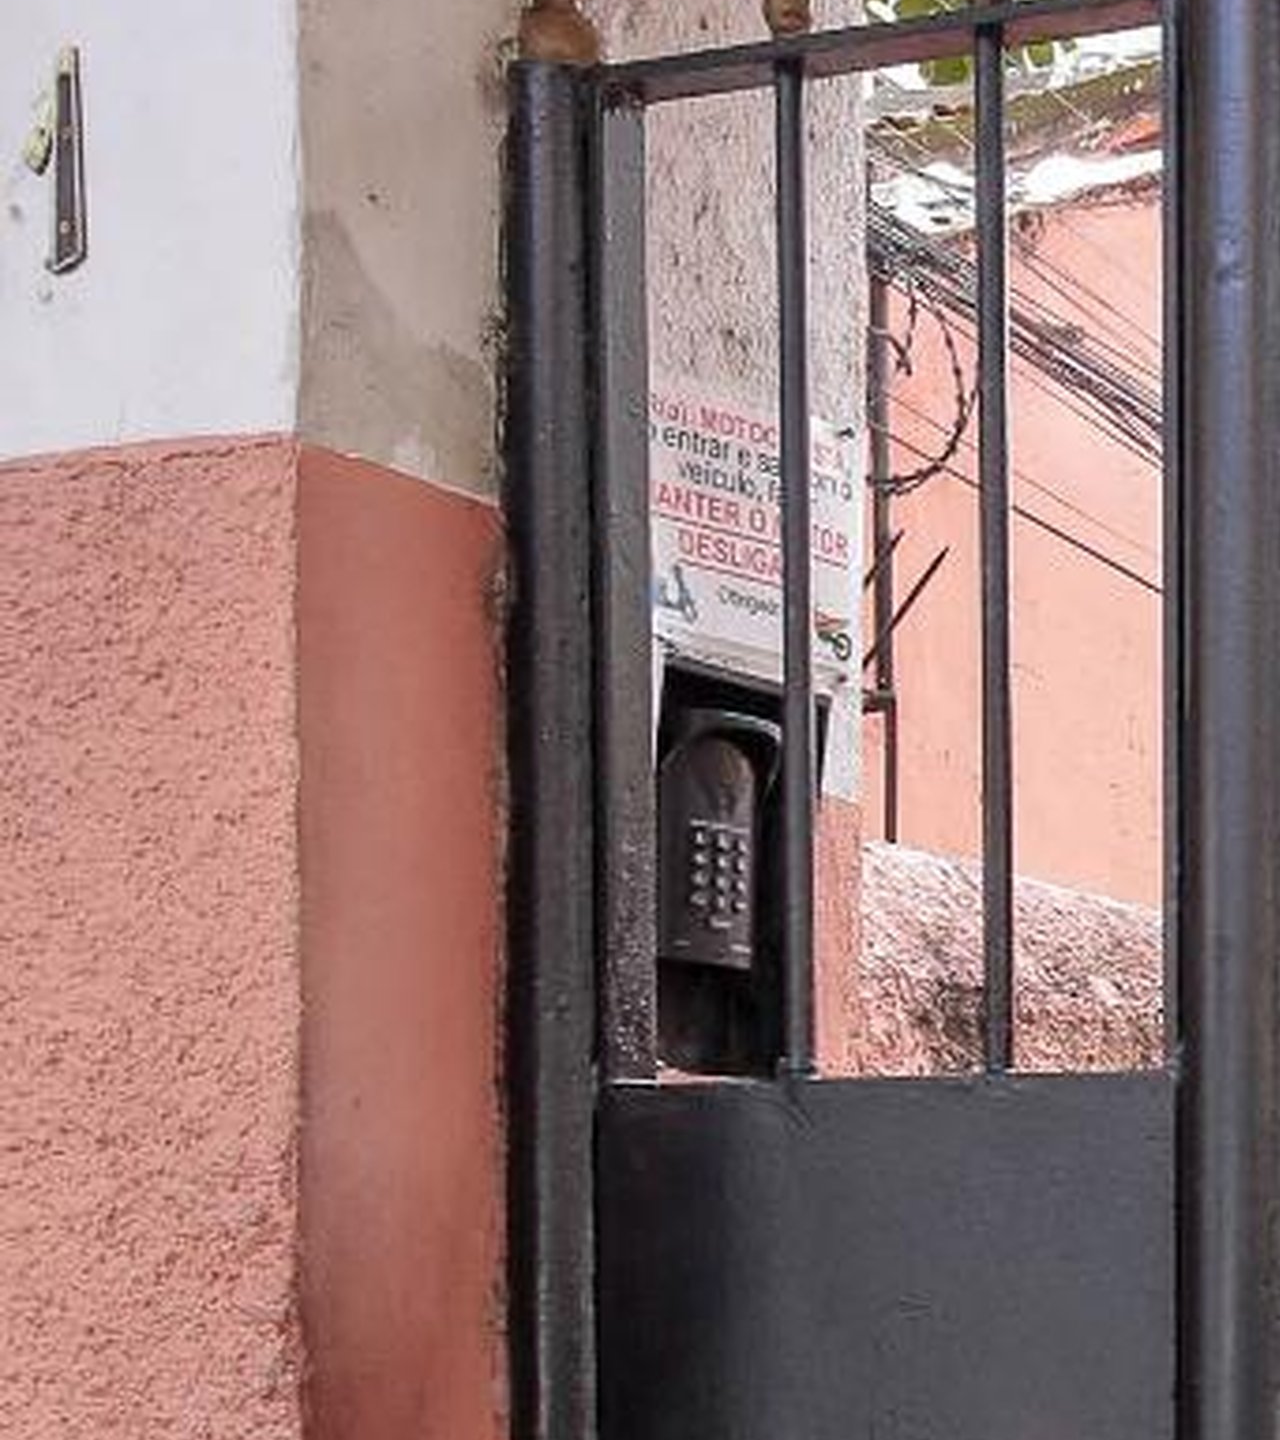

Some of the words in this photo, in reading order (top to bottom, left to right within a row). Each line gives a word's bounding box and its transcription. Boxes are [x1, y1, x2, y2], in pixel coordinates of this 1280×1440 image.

[663, 426, 729, 460] entrar
[656, 482, 741, 526] ANTER
[677, 526, 782, 579] DESLIGA
